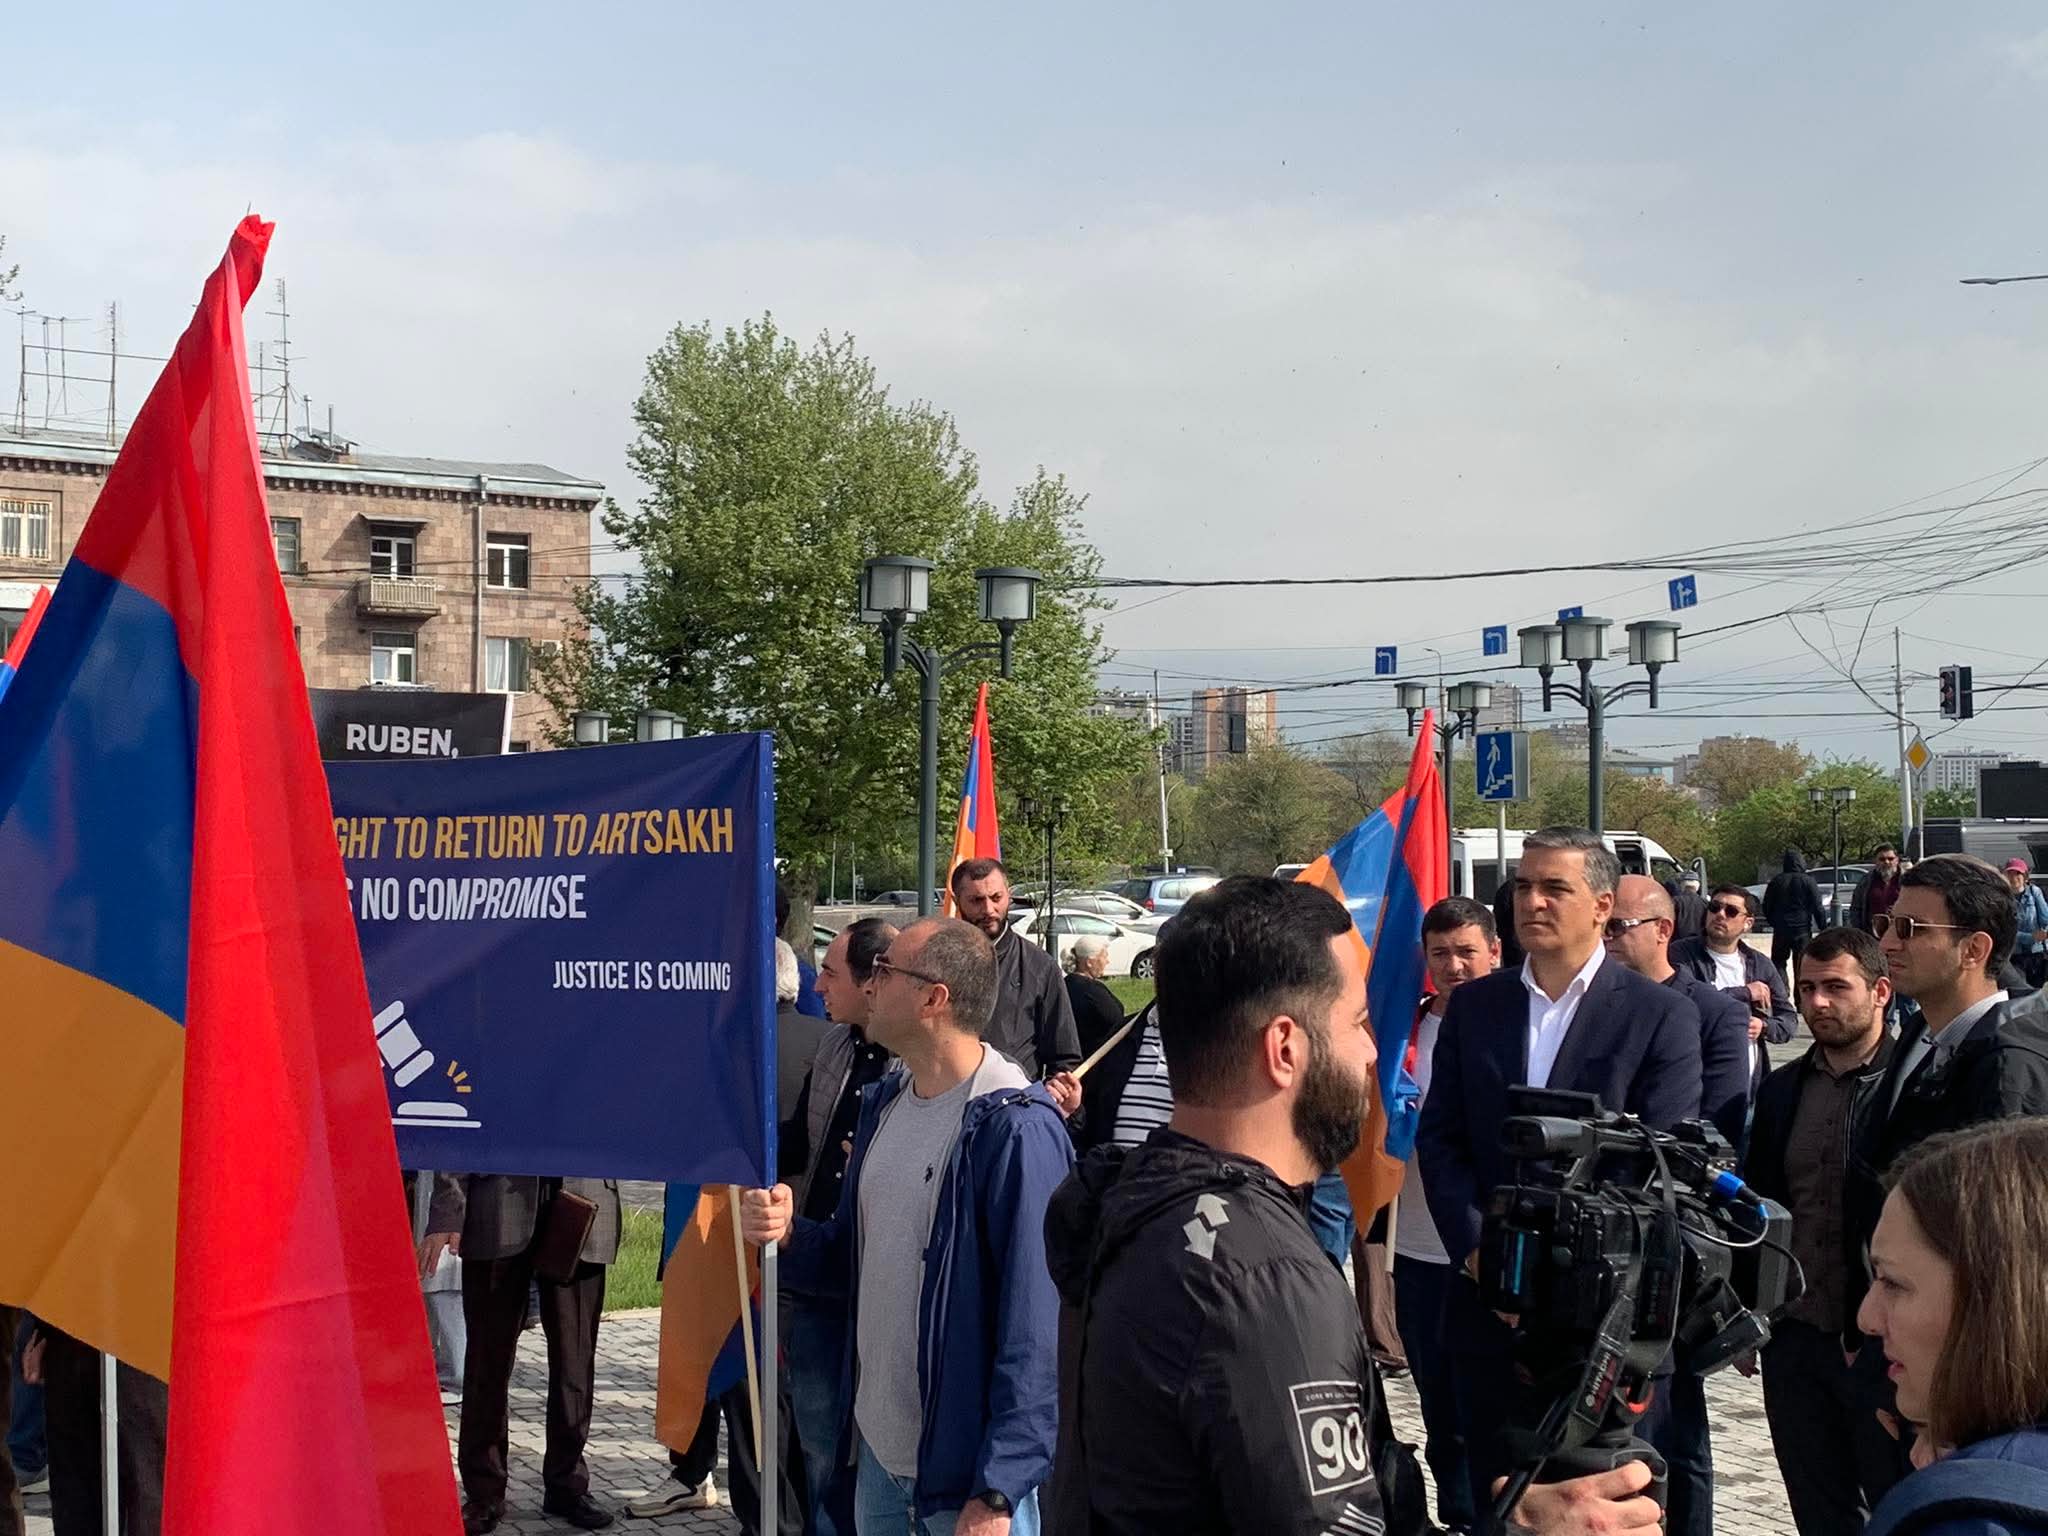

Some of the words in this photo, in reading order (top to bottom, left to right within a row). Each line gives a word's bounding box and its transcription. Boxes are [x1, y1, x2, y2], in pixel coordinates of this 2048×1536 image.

[346, 723, 459, 759] RUBEN,
[393, 816, 429, 859] TO
[434, 814, 545, 859] RETURN
[553, 813, 588, 857] TO
[588, 808, 734, 855] ARTSAKH
[361, 877, 400, 921] NO
[408, 874, 587, 921] COMPROMISE
[553, 961, 629, 990] JUSTICE
[634, 961, 653, 990] IS
[658, 961, 731, 991] COMING
[1311, 1412, 1366, 1479] 90
